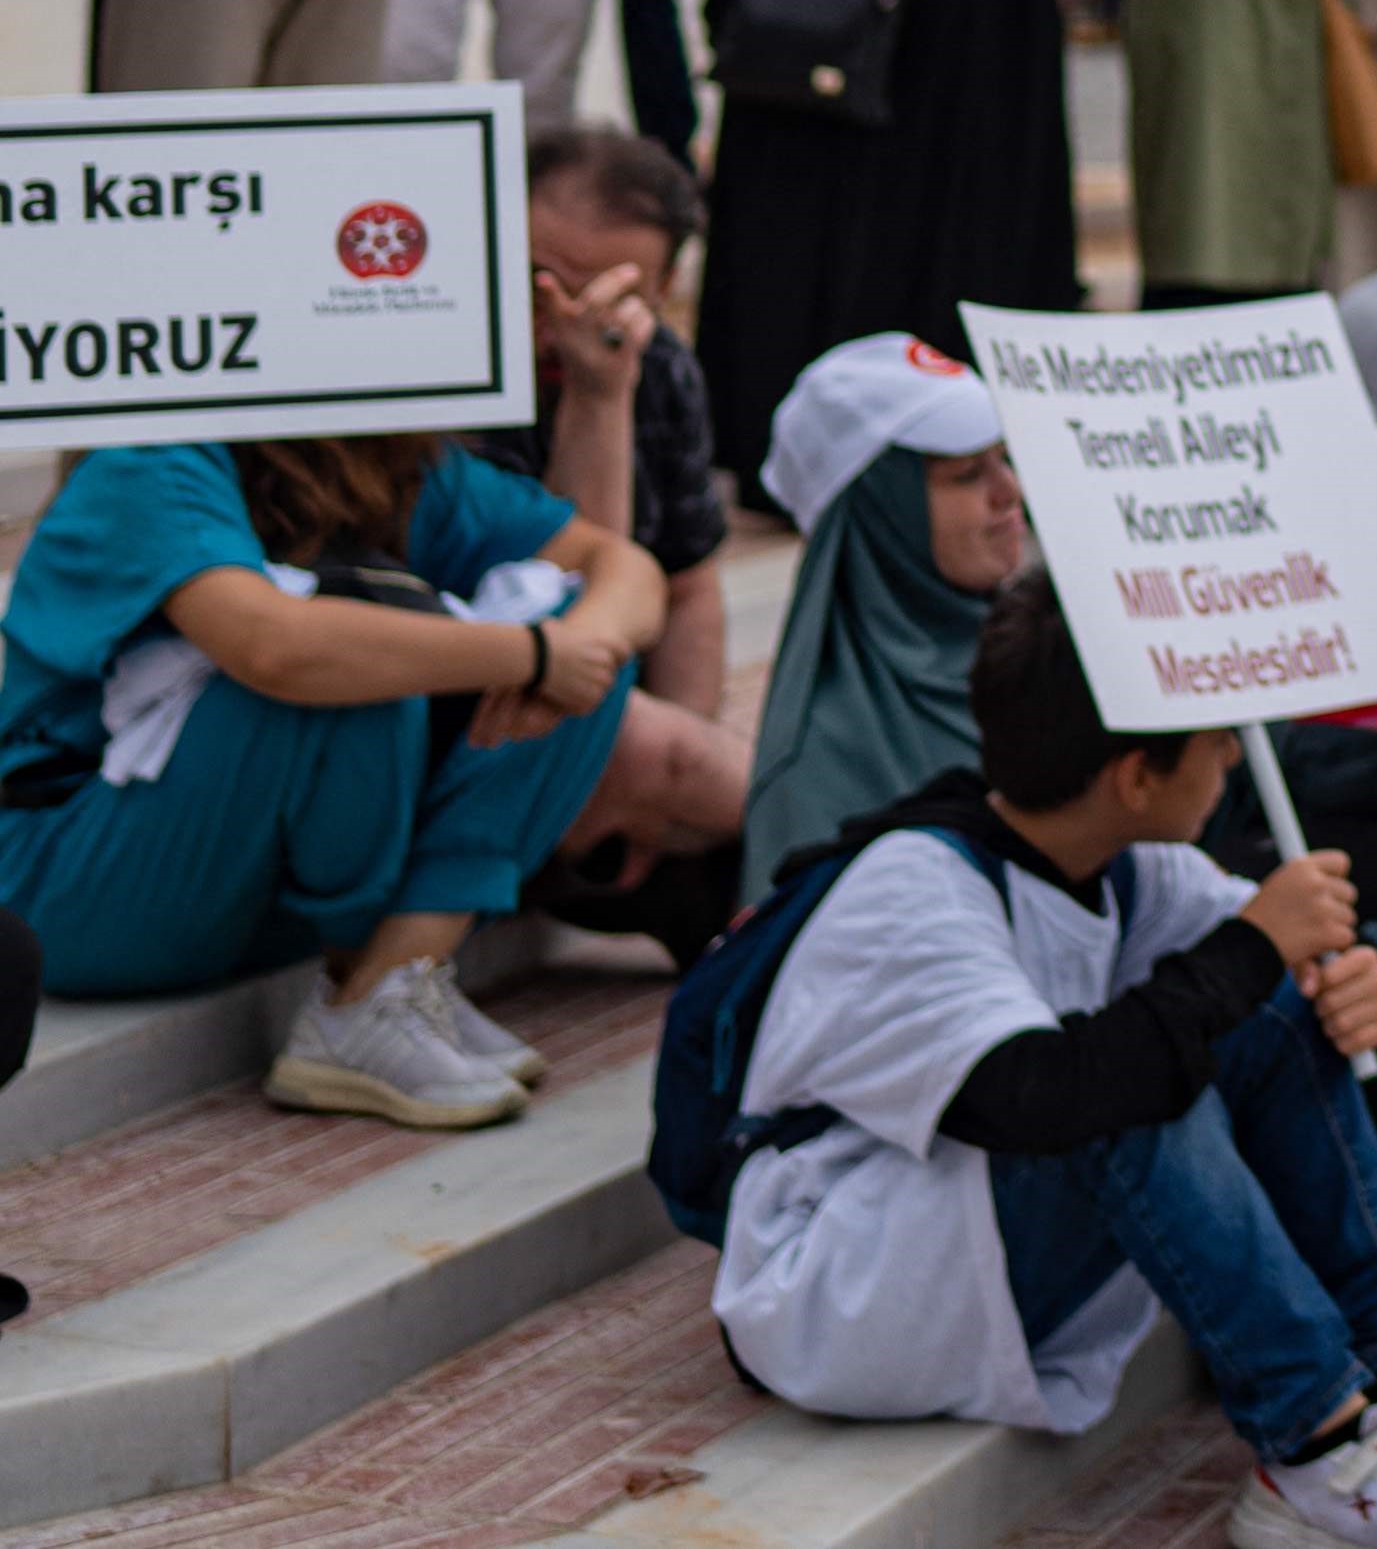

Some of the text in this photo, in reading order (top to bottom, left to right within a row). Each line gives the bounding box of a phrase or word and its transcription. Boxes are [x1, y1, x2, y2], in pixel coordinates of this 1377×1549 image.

[83, 162, 263, 232] karşı
[1042, 330, 1335, 405] Medeniyetimizin
[1064, 406, 1284, 473] Temeli Aileyi
[1115, 484, 1280, 544] Korumak
[1114, 548, 1340, 620] Milli Güvenlik
